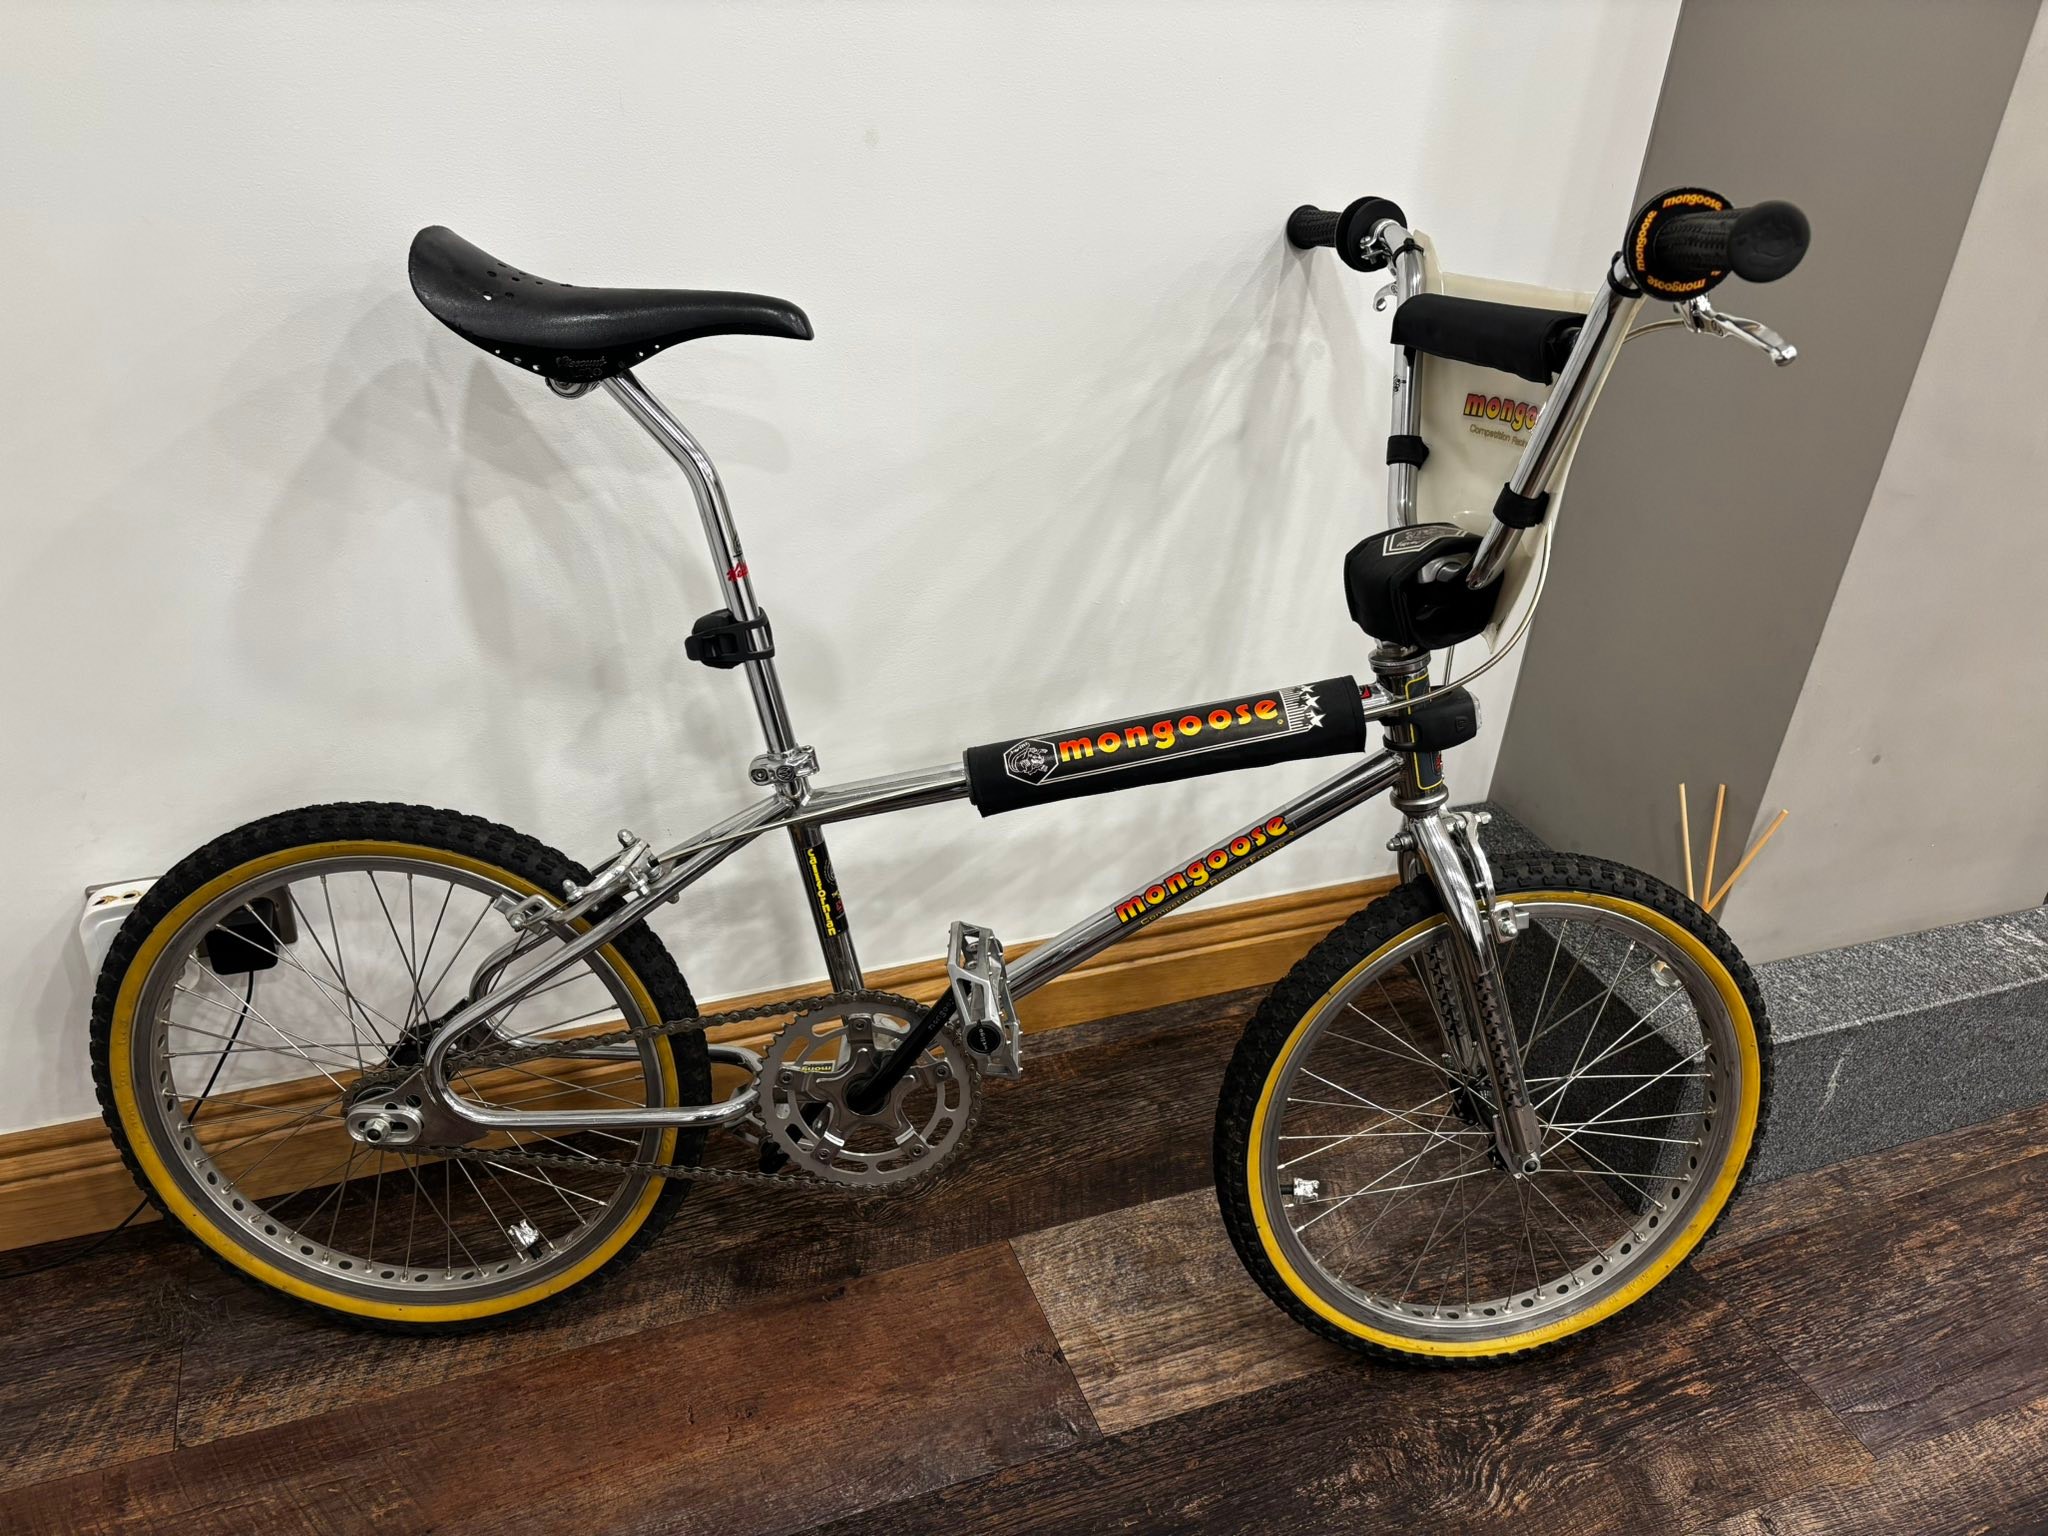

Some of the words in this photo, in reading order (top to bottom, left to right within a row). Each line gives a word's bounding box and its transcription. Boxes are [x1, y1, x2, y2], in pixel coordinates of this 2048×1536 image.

[1661, 193, 1723, 212] mongoose
[1635, 210, 1658, 272] mongoose
[1646, 275, 1707, 293] mongoose
[1463, 392, 1539, 432] mongo
[1058, 699, 1280, 764] mongoose
[1113, 815, 1290, 925] mongoose
[1140, 886, 1207, 926] Competition
[1209, 863, 1249, 888] Racing
[1249, 842, 1286, 864] Frame
